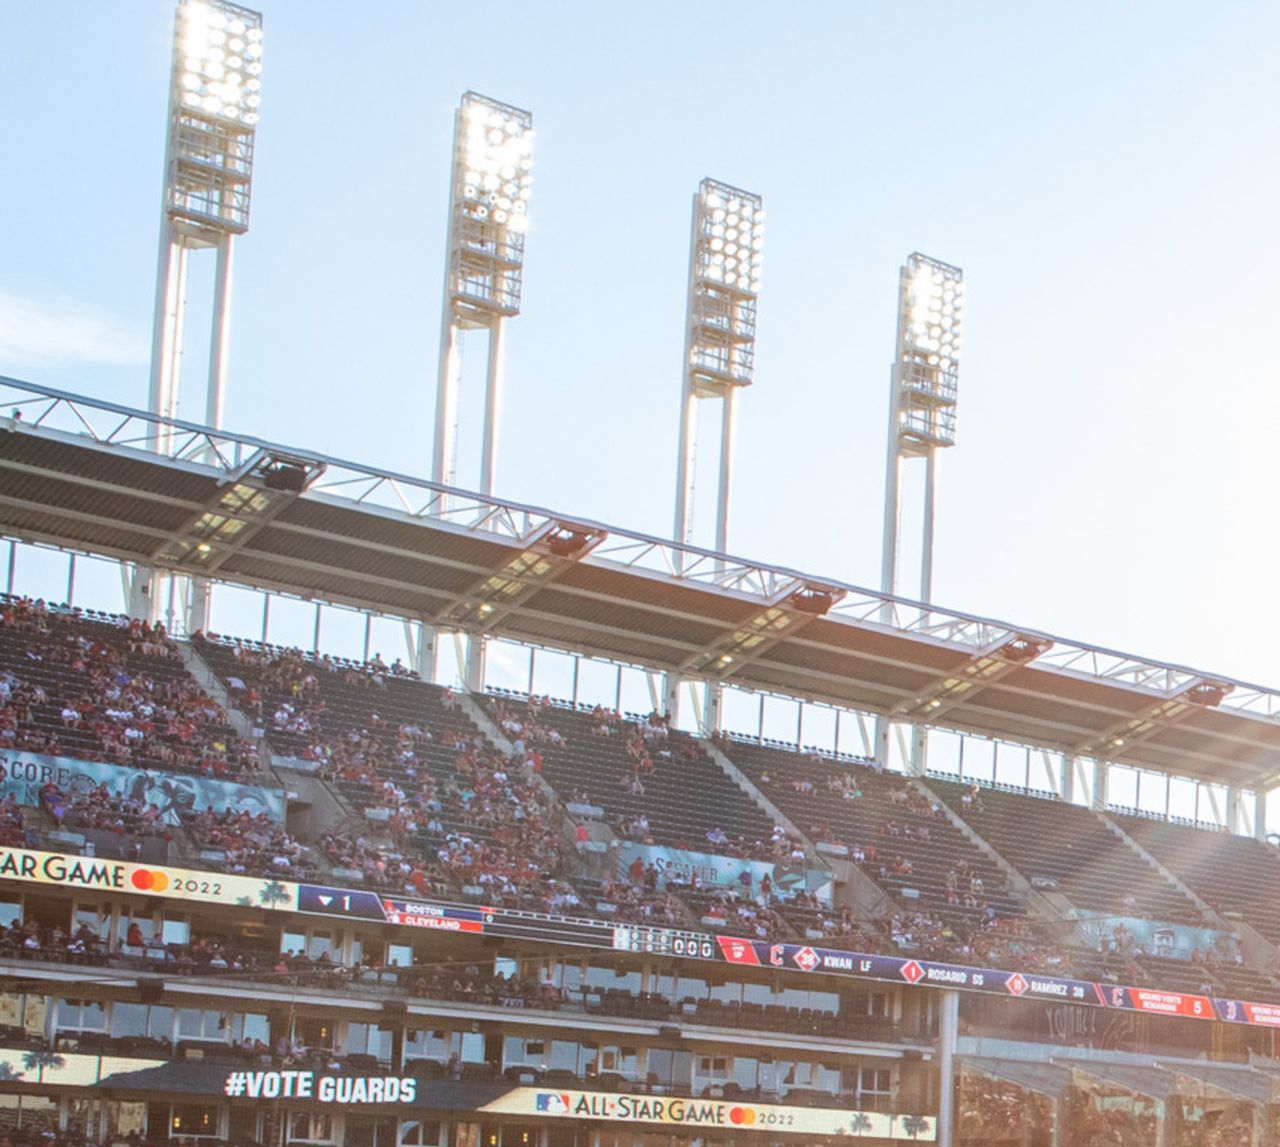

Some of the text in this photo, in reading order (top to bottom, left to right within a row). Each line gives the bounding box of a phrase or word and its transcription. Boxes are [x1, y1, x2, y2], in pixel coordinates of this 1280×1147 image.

[43, 855, 222, 896] GAME 2022
[342, 895, 351, 911] 1
[405, 903, 444, 917] BOSTON
[404, 915, 460, 931] CLEVELAND
[824, 955, 852, 970] KWAN
[860, 959, 872, 972] LF
[972, 974, 984, 986] SS
[1193, 1000, 1202, 1014] 5
[225, 1070, 416, 1104] #VOTE GUARDS
[668, 1100, 726, 1125] GAME
[759, 1112, 795, 1126] 2022
